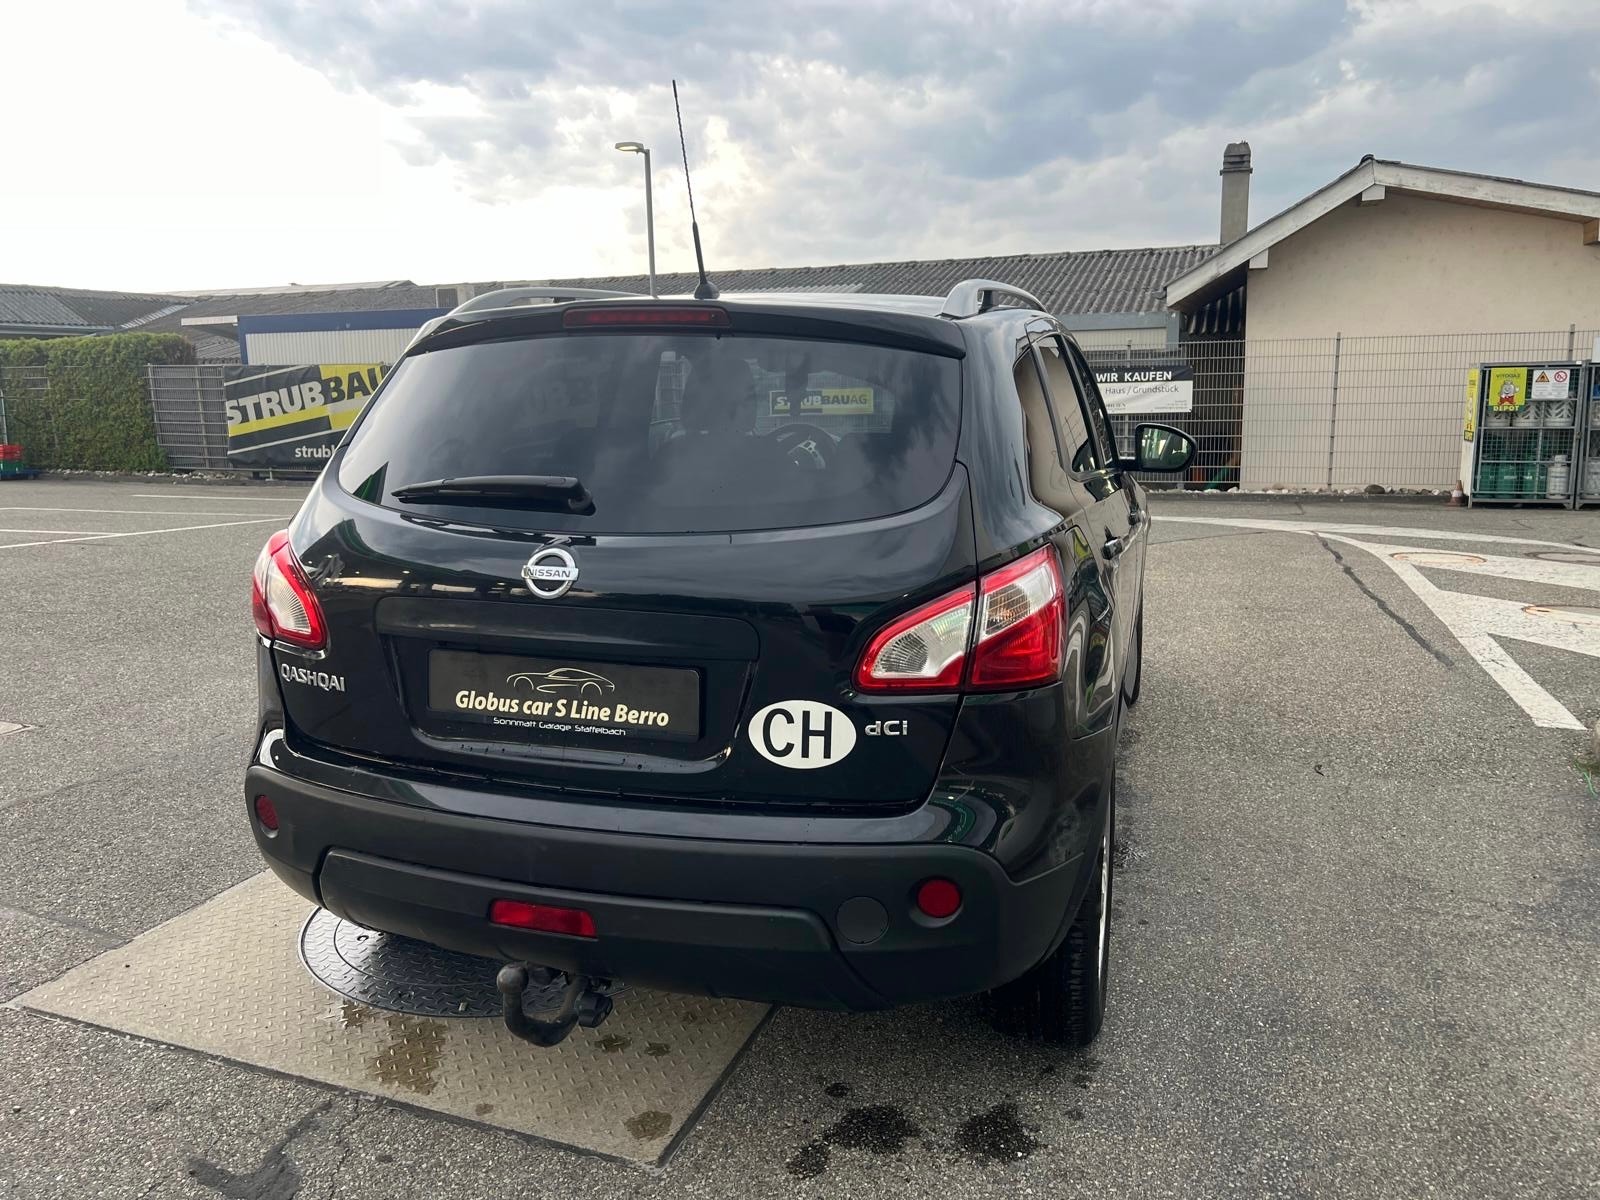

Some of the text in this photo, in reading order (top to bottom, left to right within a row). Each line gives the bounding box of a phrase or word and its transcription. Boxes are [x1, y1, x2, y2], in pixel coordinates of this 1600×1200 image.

[1096, 371, 1172, 382] WIR KAUFEN
[1105, 386, 1126, 394] Haus
[526, 568, 571, 578] NISSAN
[281, 663, 345, 692] QASHQAI
[455, 690, 669, 727] Globus car S Line Berro
[493, 717, 626, 736] Sonnmatt Garage Staffelbach
[762, 708, 833, 759] CH
[864, 720, 908, 736] dCi
